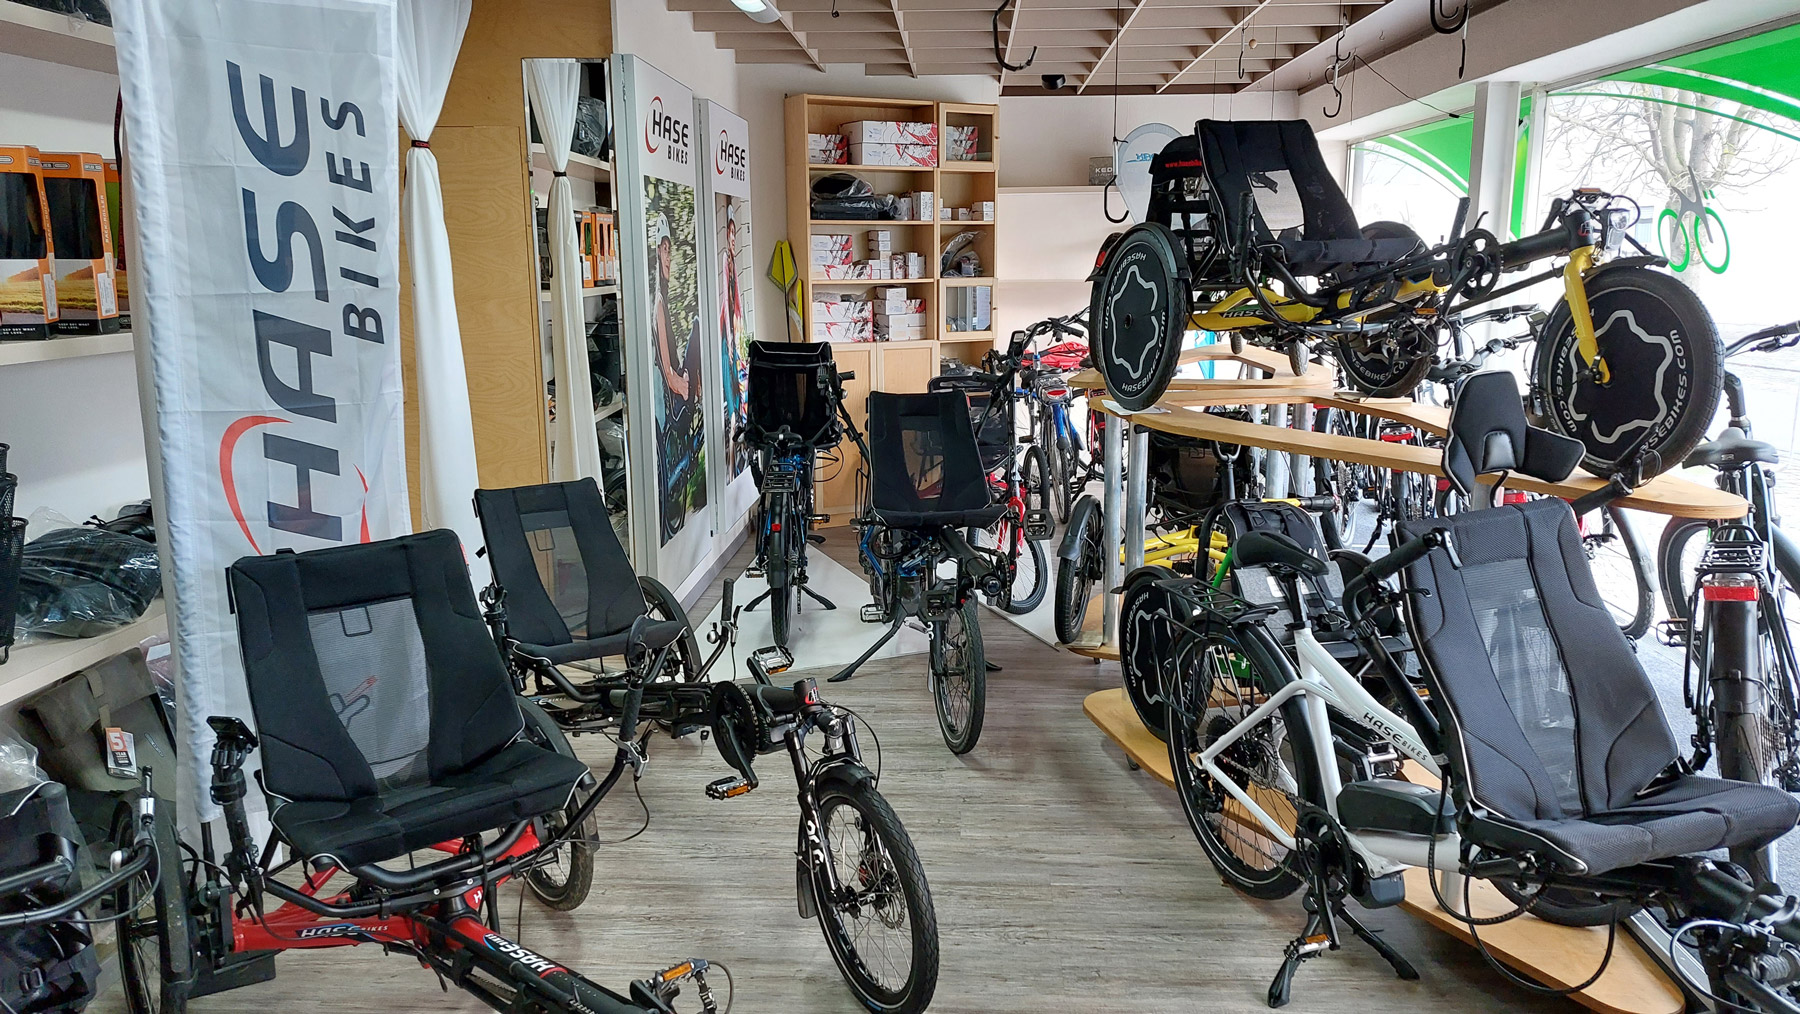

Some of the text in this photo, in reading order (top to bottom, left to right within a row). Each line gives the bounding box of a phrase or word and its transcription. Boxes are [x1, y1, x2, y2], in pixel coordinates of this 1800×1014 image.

[652, 109, 689, 148] HASE
[667, 145, 688, 165] BIKES
[720, 139, 746, 168] HASE
[731, 166, 745, 182] BIKES
[320, 96, 385, 345] BIKES
[226, 60, 343, 542] HASE
[1222, 310, 1264, 318] HASE
[109, 732, 124, 750] 5
[1363, 712, 1428, 761] HASE BIKES
[499, 942, 555, 972] HASE
